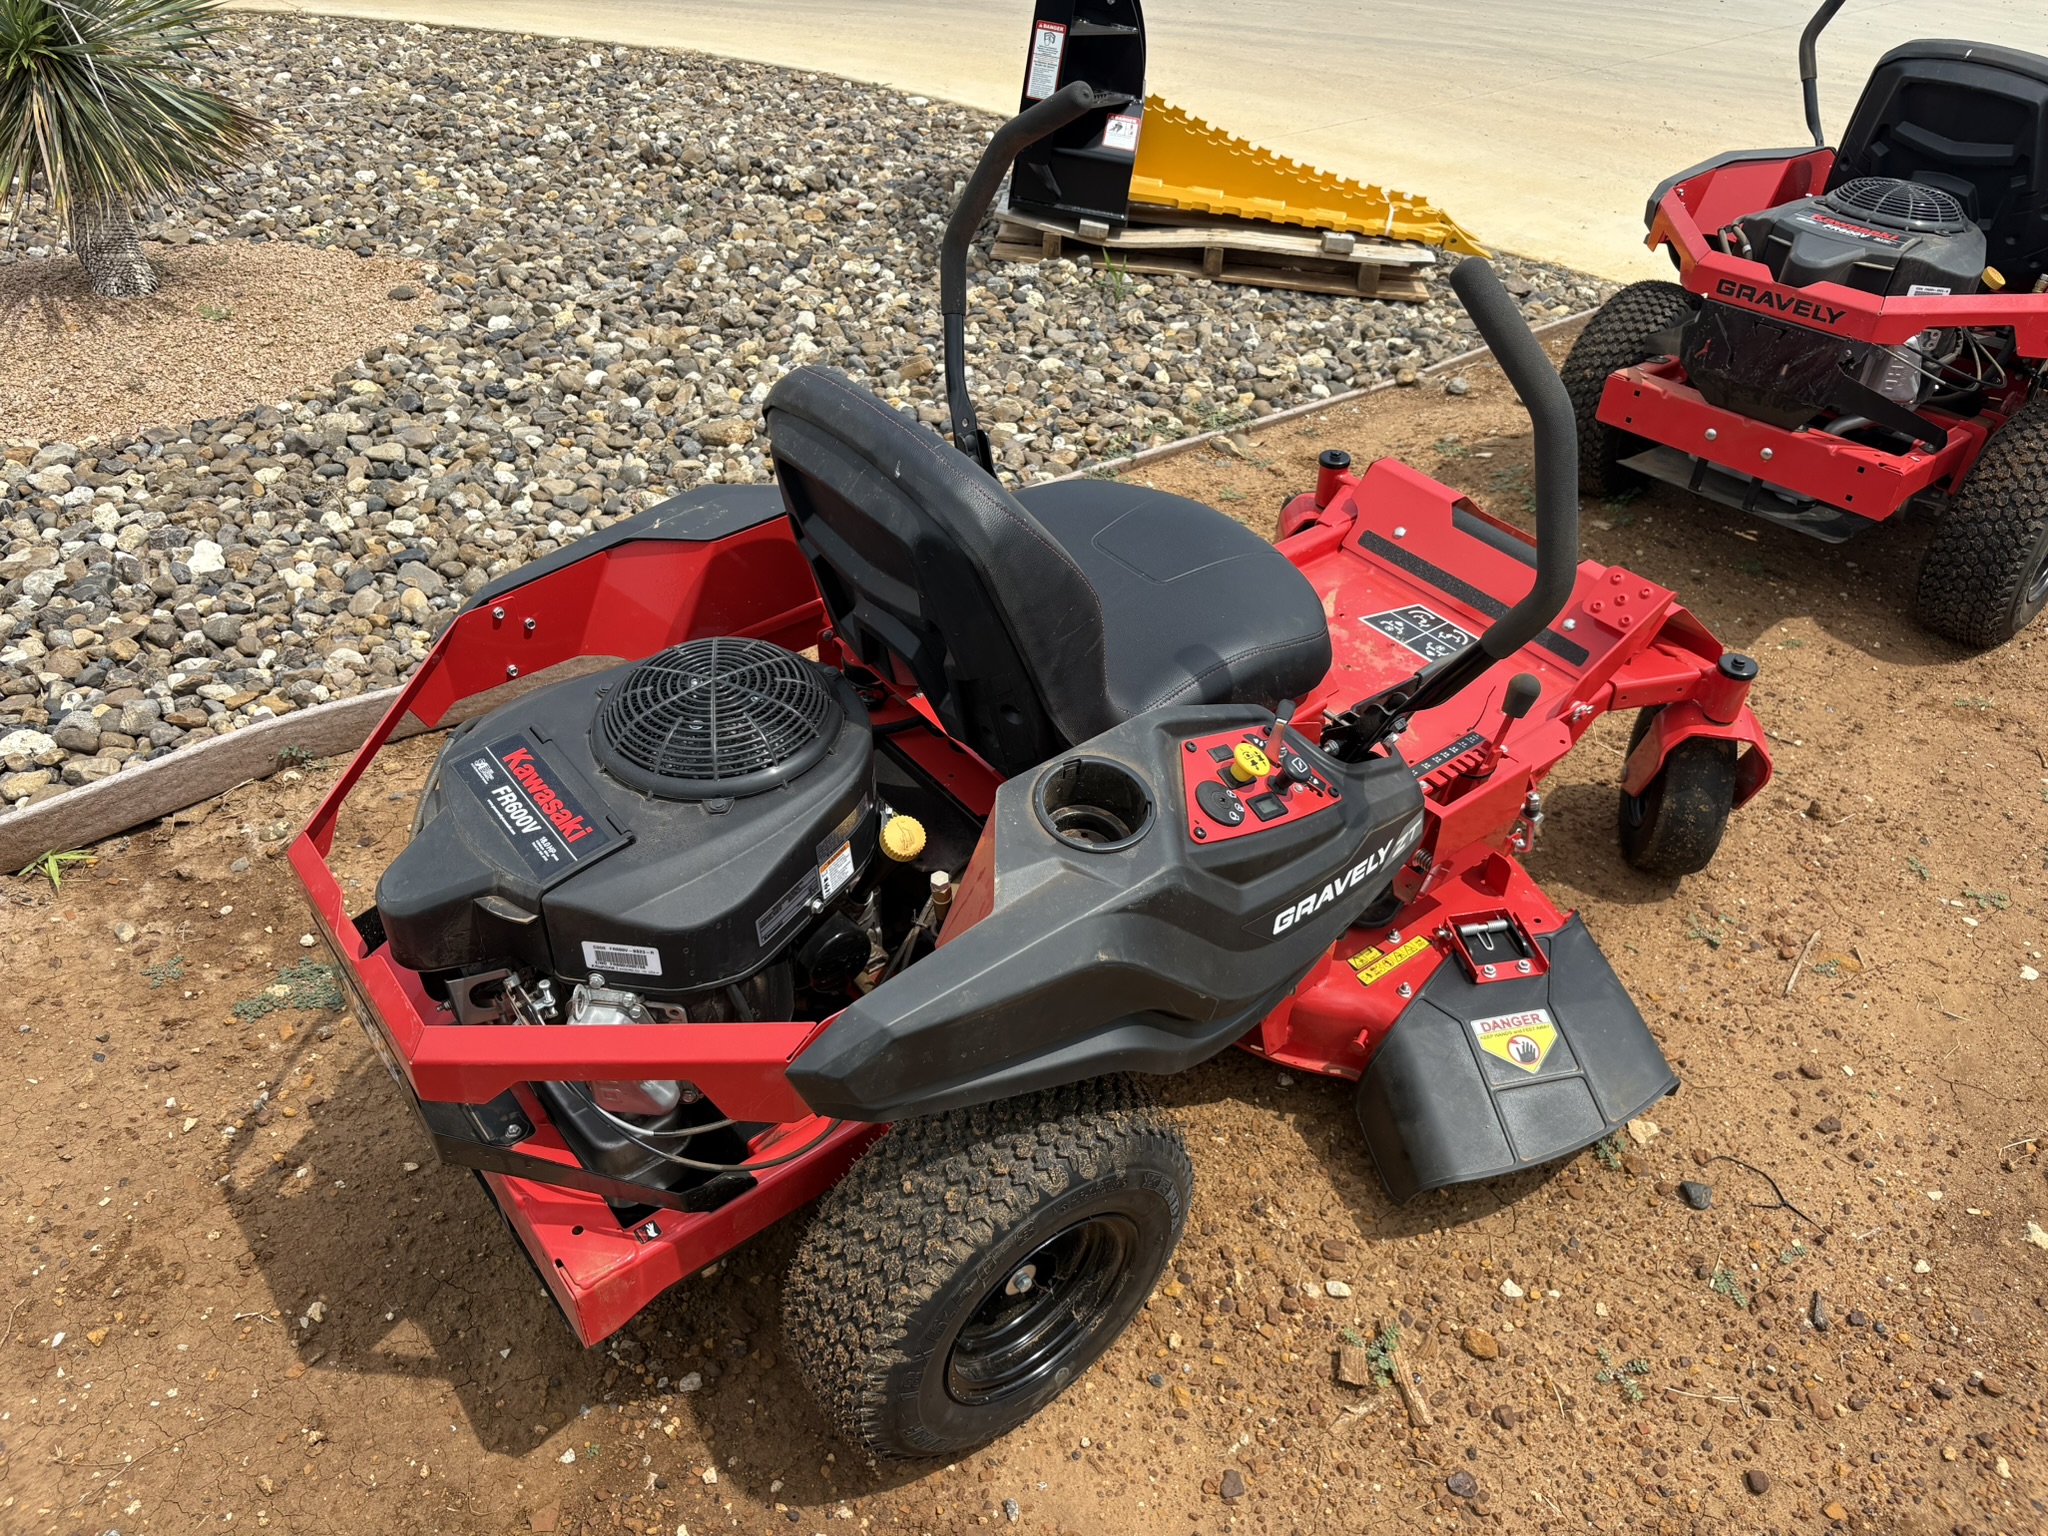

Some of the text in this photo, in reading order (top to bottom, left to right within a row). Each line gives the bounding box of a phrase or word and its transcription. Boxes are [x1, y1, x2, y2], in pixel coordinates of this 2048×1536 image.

[1043, 23, 1064, 32] DANGER
[1811, 214, 1900, 241] Kawasaki
[1716, 278, 1847, 324] GRAVELY
[491, 785, 542, 834] FR600V
[502, 747, 594, 844] Kawasaki
[1272, 818, 1422, 936] GRAVELY ZT
[1480, 1013, 1542, 1033] DANGER
[1494, 1030, 1512, 1038] HANDS
